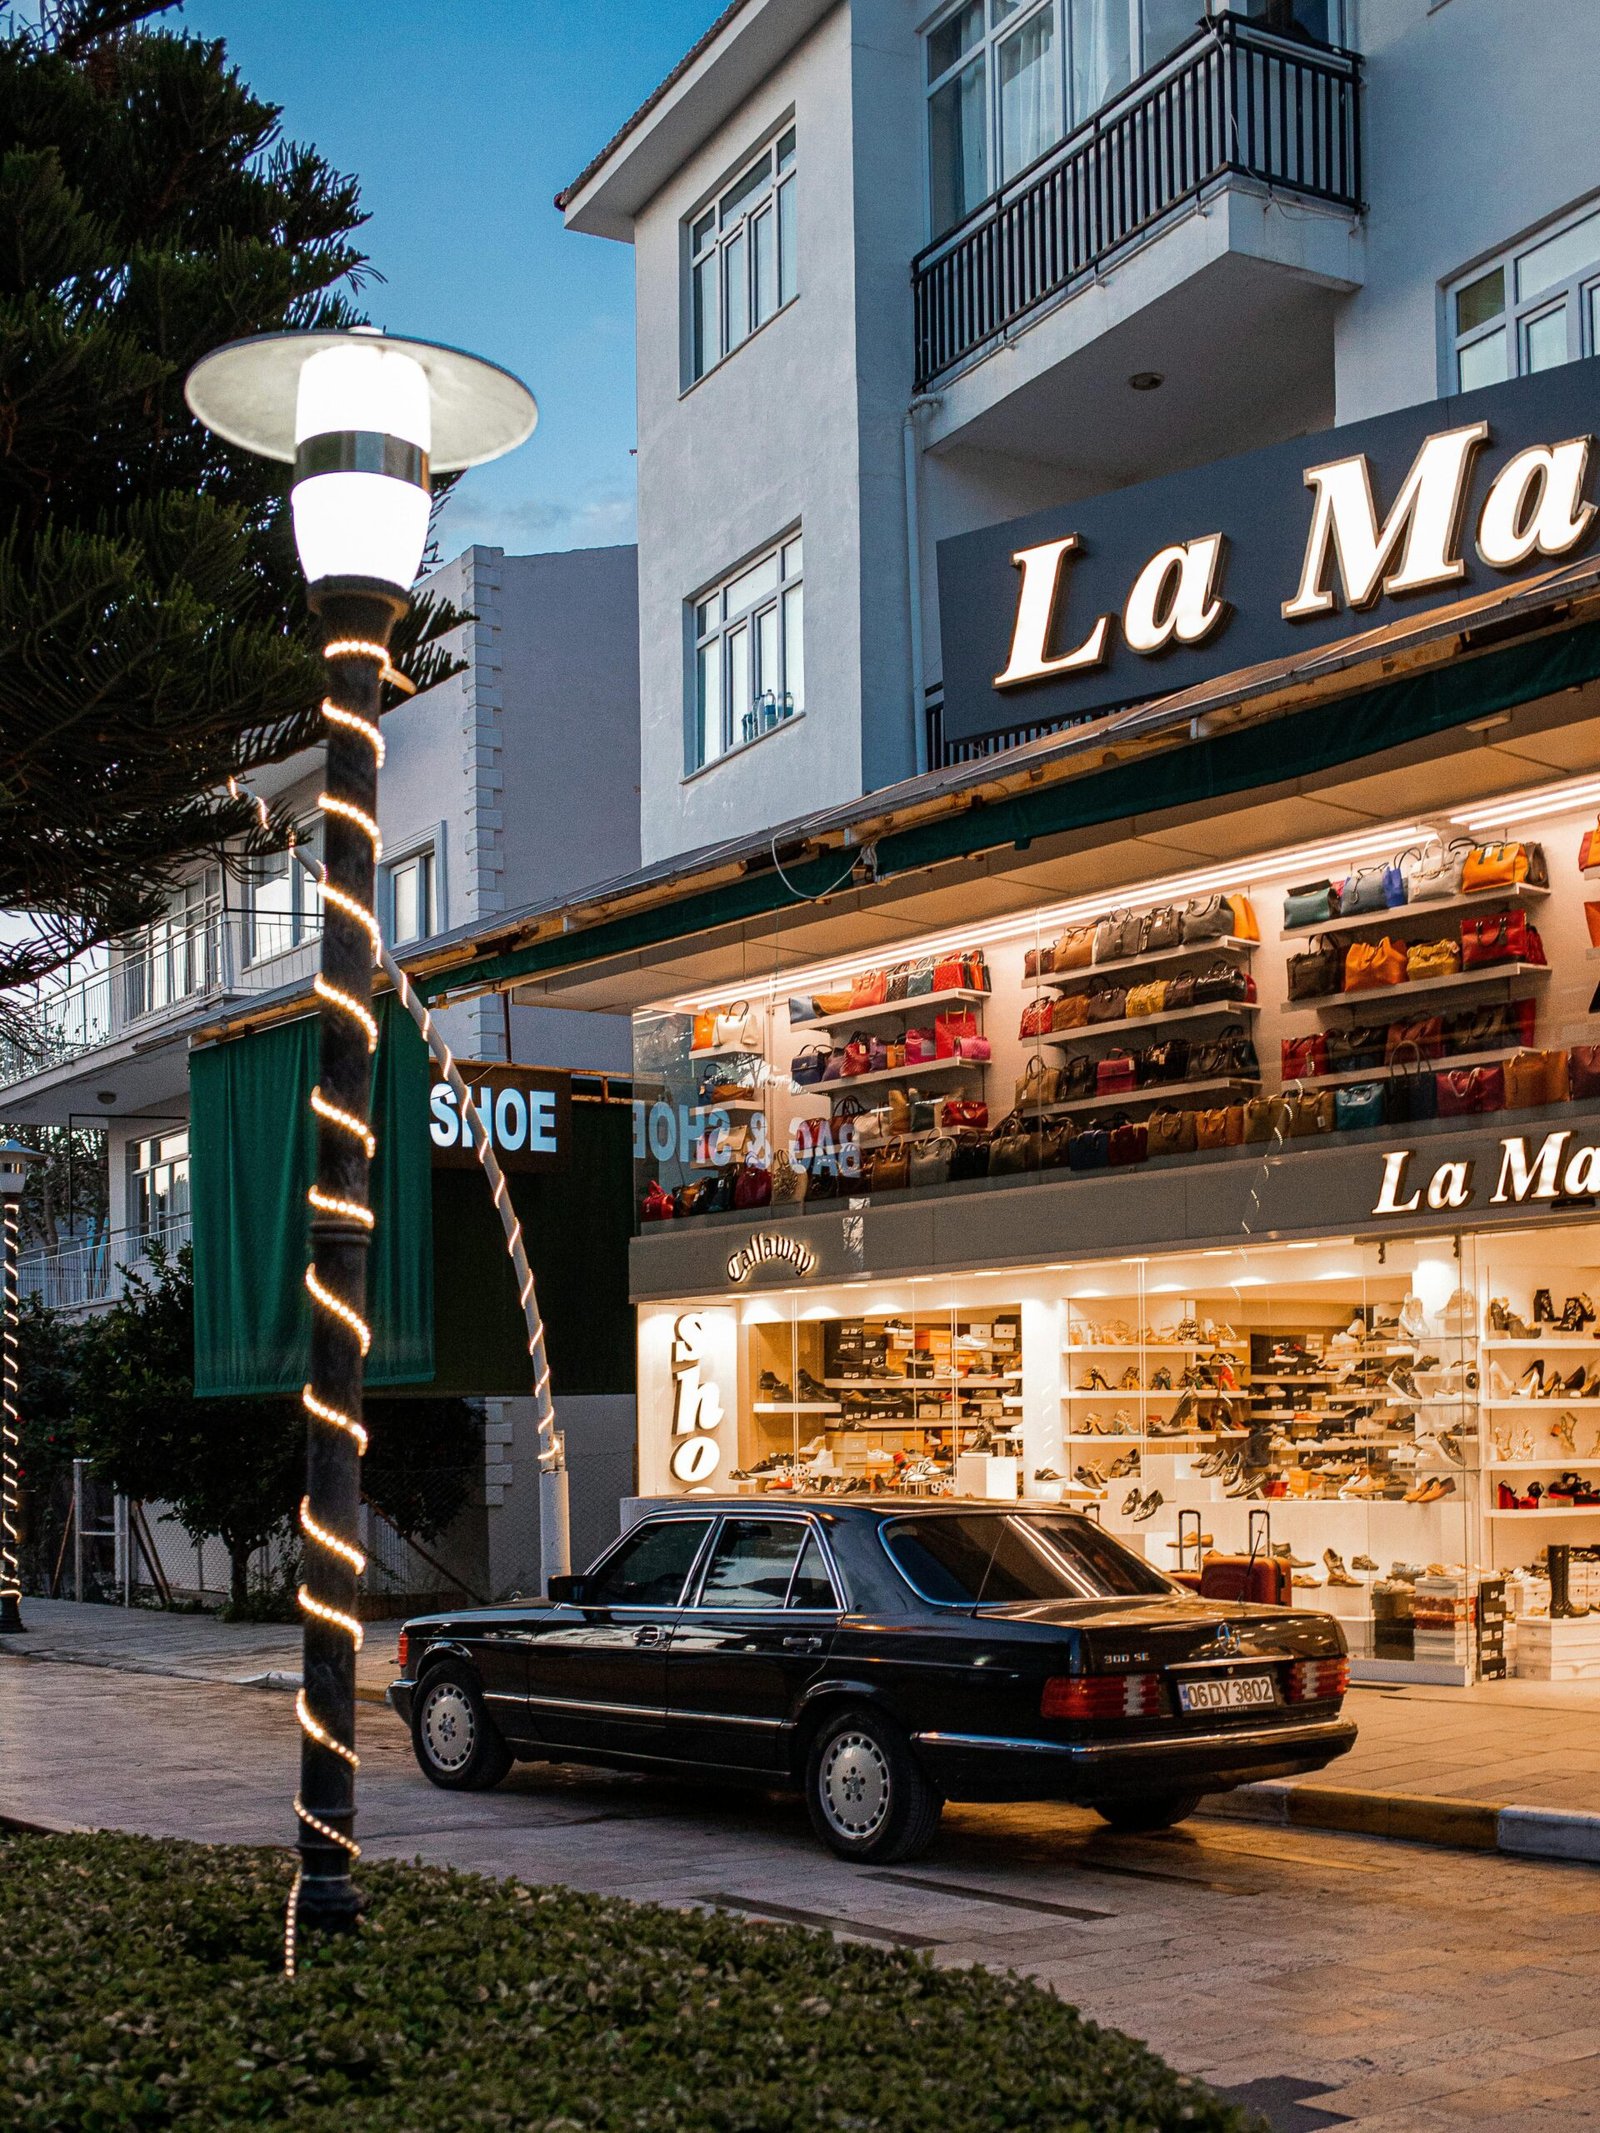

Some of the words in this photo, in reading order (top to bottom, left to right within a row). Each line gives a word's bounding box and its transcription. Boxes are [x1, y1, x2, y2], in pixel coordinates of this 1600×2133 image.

[992, 531, 1229, 689] La
[1281, 419, 1598, 619] Ma
[429, 1083, 557, 1152] SHOE
[1371, 1150, 1471, 1214] La
[1489, 1130, 1600, 1203] Ma
[727, 1232, 816, 1283] Callaway
[1104, 1654, 1130, 1664] 300
[1133, 1652, 1150, 1662] SE
[1232, 1678, 1273, 1703] 3802
